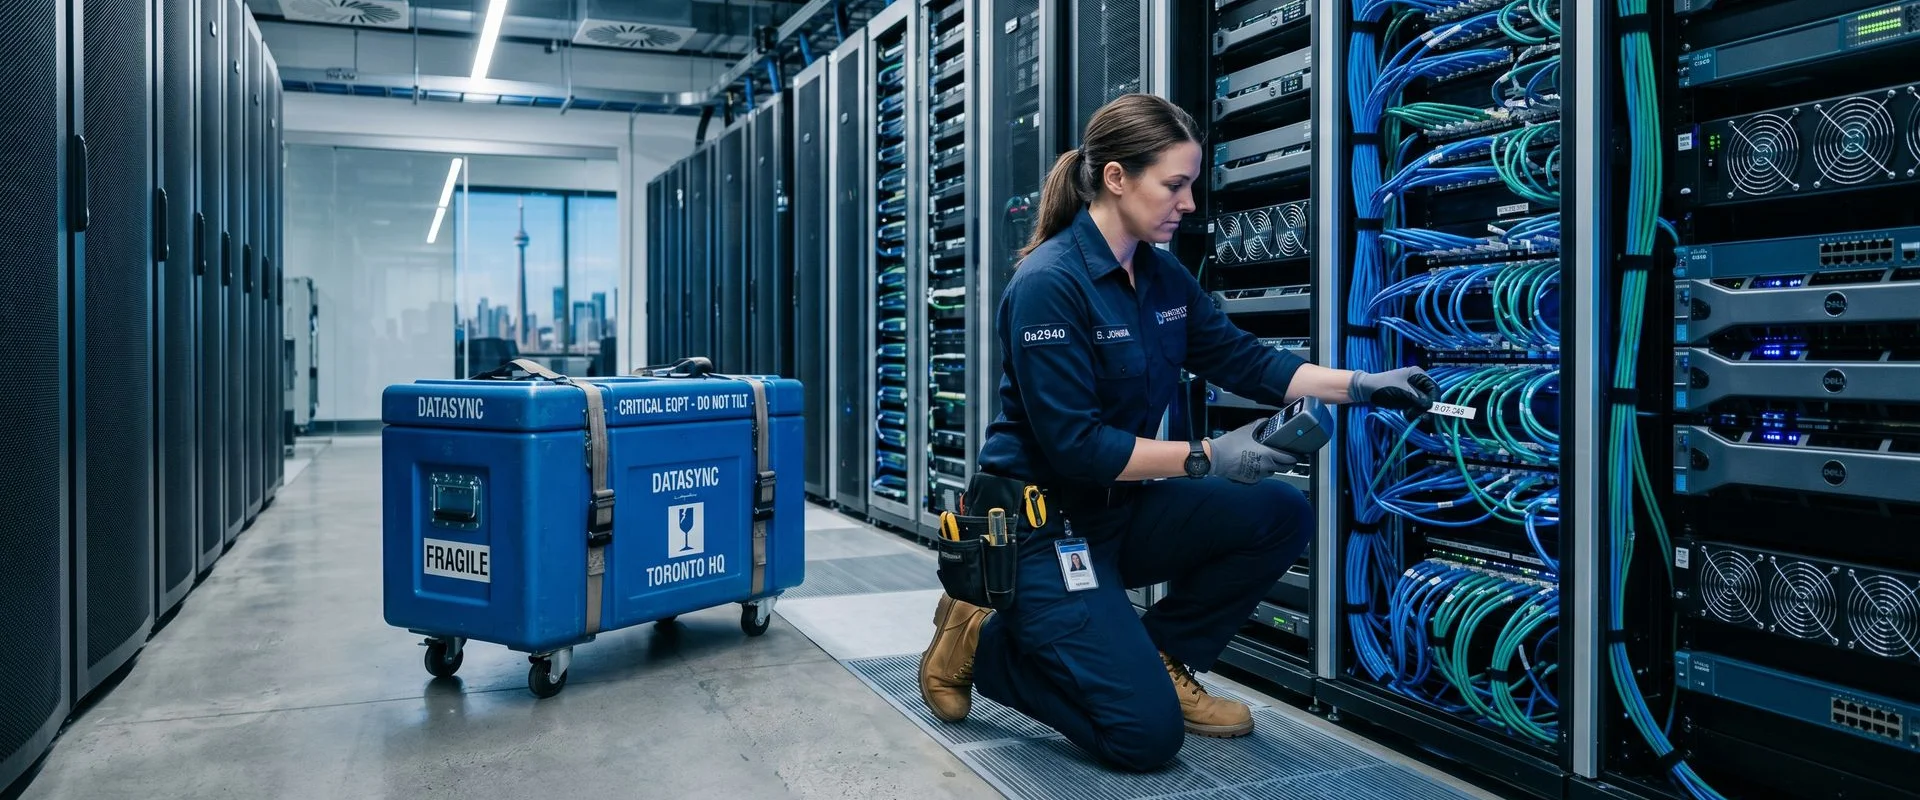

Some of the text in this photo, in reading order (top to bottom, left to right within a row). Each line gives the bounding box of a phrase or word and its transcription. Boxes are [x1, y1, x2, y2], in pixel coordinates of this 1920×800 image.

[1024, 328, 1066, 342] 0a2940
[418, 396, 484, 419] DATASYNC
[619, 397, 663, 415] CRITICAL
[665, 396, 689, 413] EQPT
[697, 395, 710, 410] DO
[712, 394, 730, 410] NOT
[731, 393, 749, 408] TILT
[652, 466, 719, 493] DATASYNC
[426, 544, 488, 576] FRAGILE
[646, 553, 725, 587] TORONTO HQ
